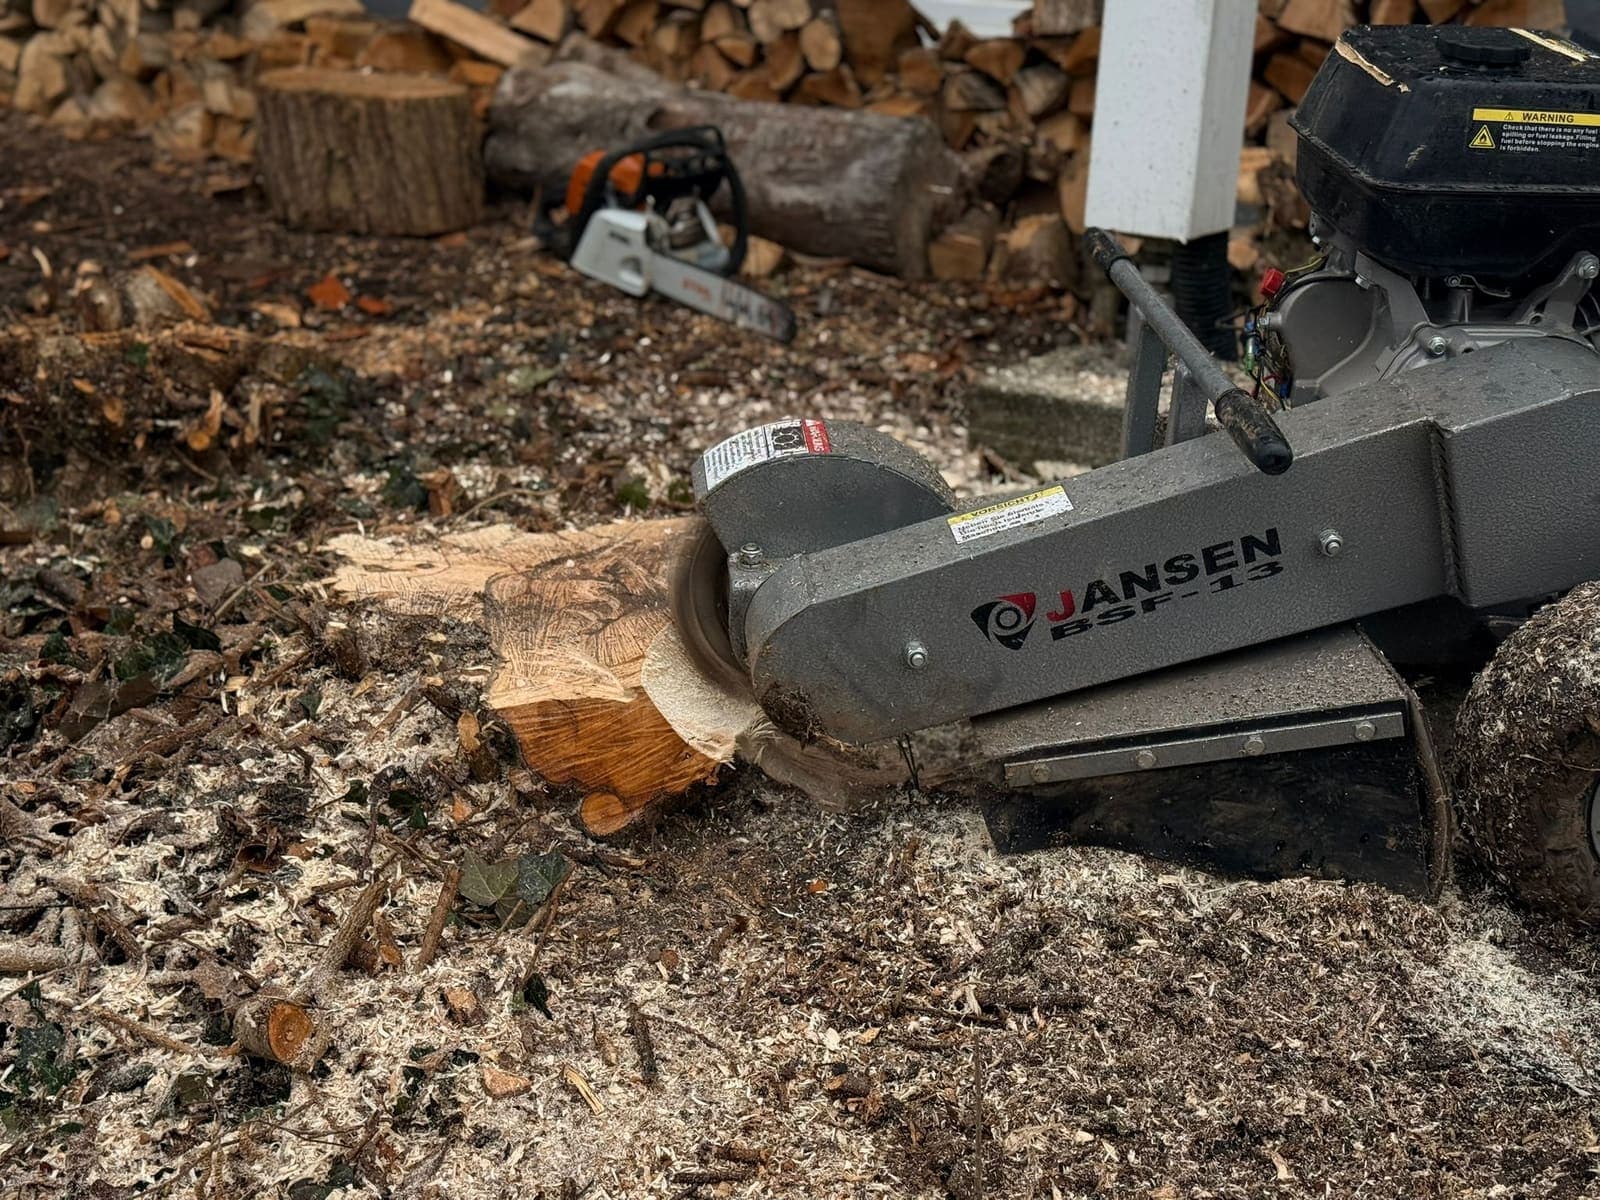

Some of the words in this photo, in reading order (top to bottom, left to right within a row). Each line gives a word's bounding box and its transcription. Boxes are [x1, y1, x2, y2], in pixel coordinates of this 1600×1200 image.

[1522, 113, 1575, 123] WARNING
[1046, 527, 1282, 622] JANSEN
[1050, 560, 1284, 641] BSF-13
